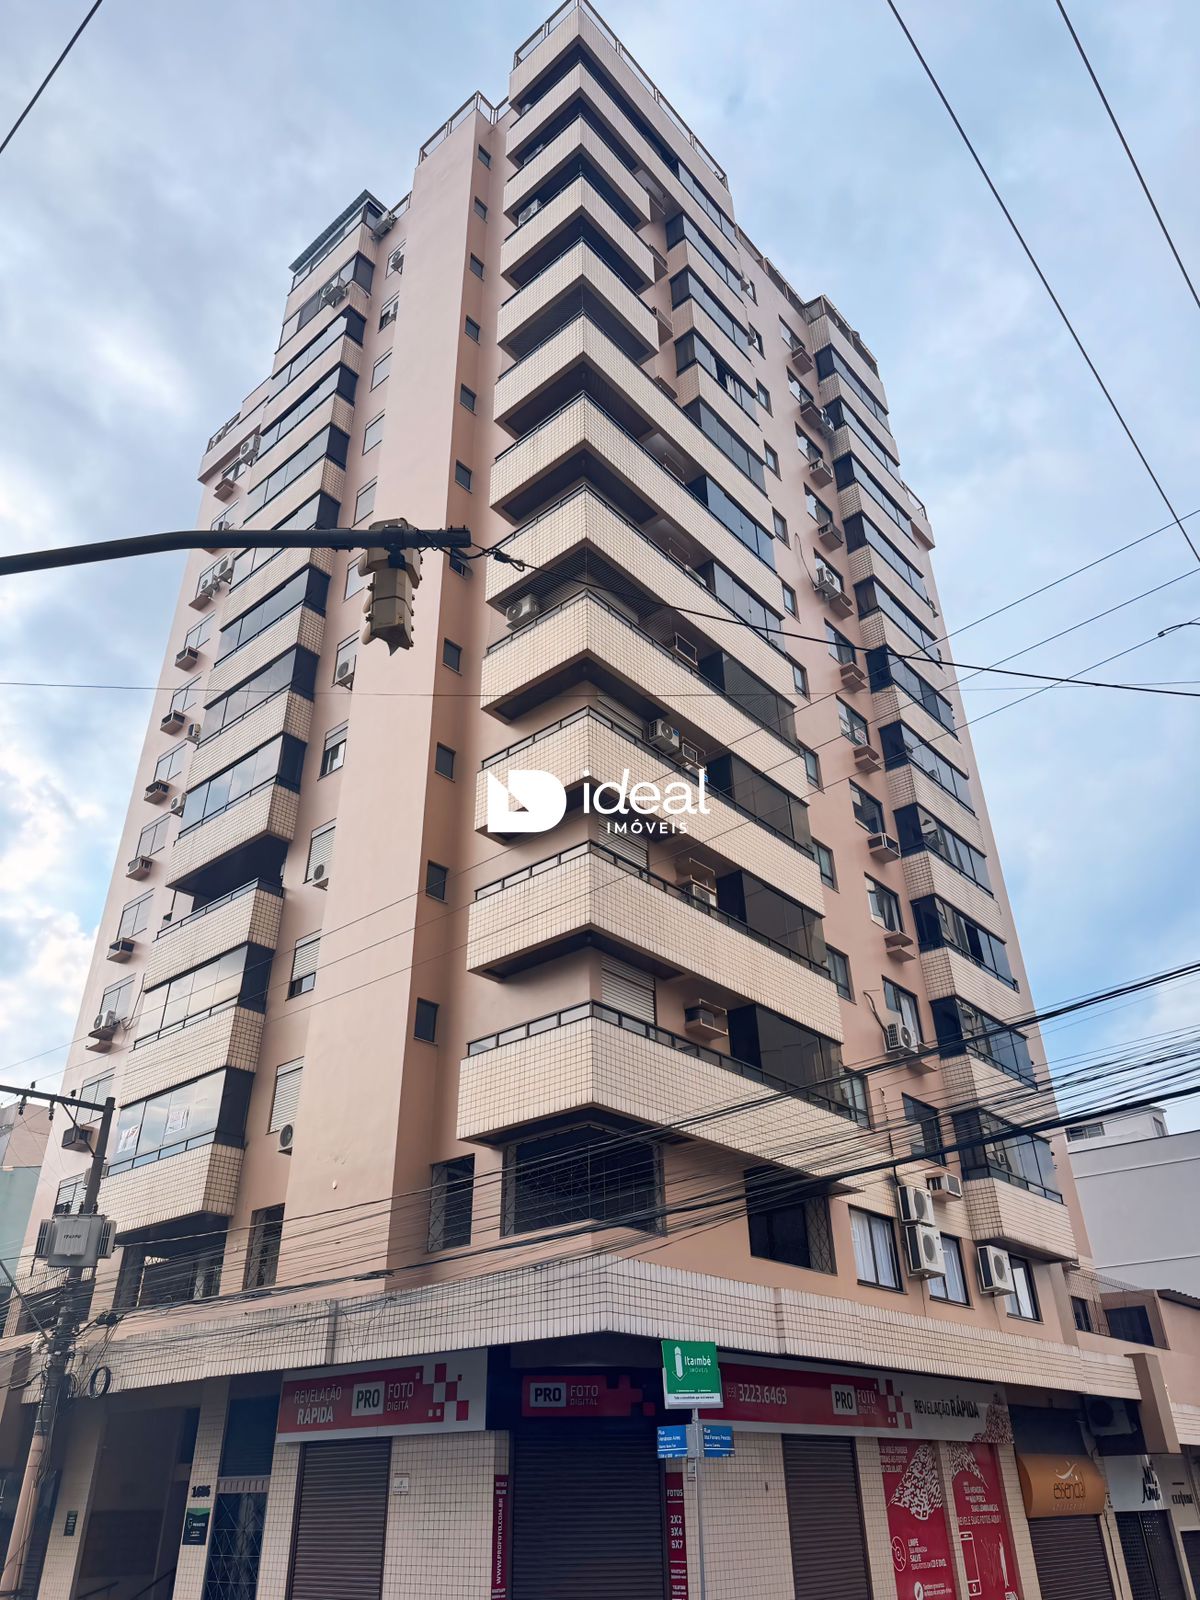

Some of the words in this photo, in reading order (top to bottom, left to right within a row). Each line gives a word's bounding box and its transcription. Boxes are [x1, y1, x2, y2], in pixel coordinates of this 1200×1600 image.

[684, 1355, 711, 1366] Itaimbé
[294, 1384, 342, 1404] REVELAÇÃO
[387, 1381, 414, 1399] FOTO
[534, 1387, 562, 1403] PRO
[570, 1385, 599, 1397] FOTO
[738, 1384, 787, 1405] 3223.6463
[857, 1390, 876, 1404] FOTO
[356, 1389, 380, 1409] PRO
[569, 1398, 599, 1406] DIGITAL
[834, 1391, 854, 1410] PRO
[914, 1399, 950, 1419] REVELAÇÃO
[949, 1394, 980, 1418] RÁPIDA
[297, 1403, 334, 1425] RÁPIDA
[667, 1489, 683, 1497] FOTOS
[670, 1515, 682, 1524] 2X2
[671, 1528, 683, 1537] 3X4
